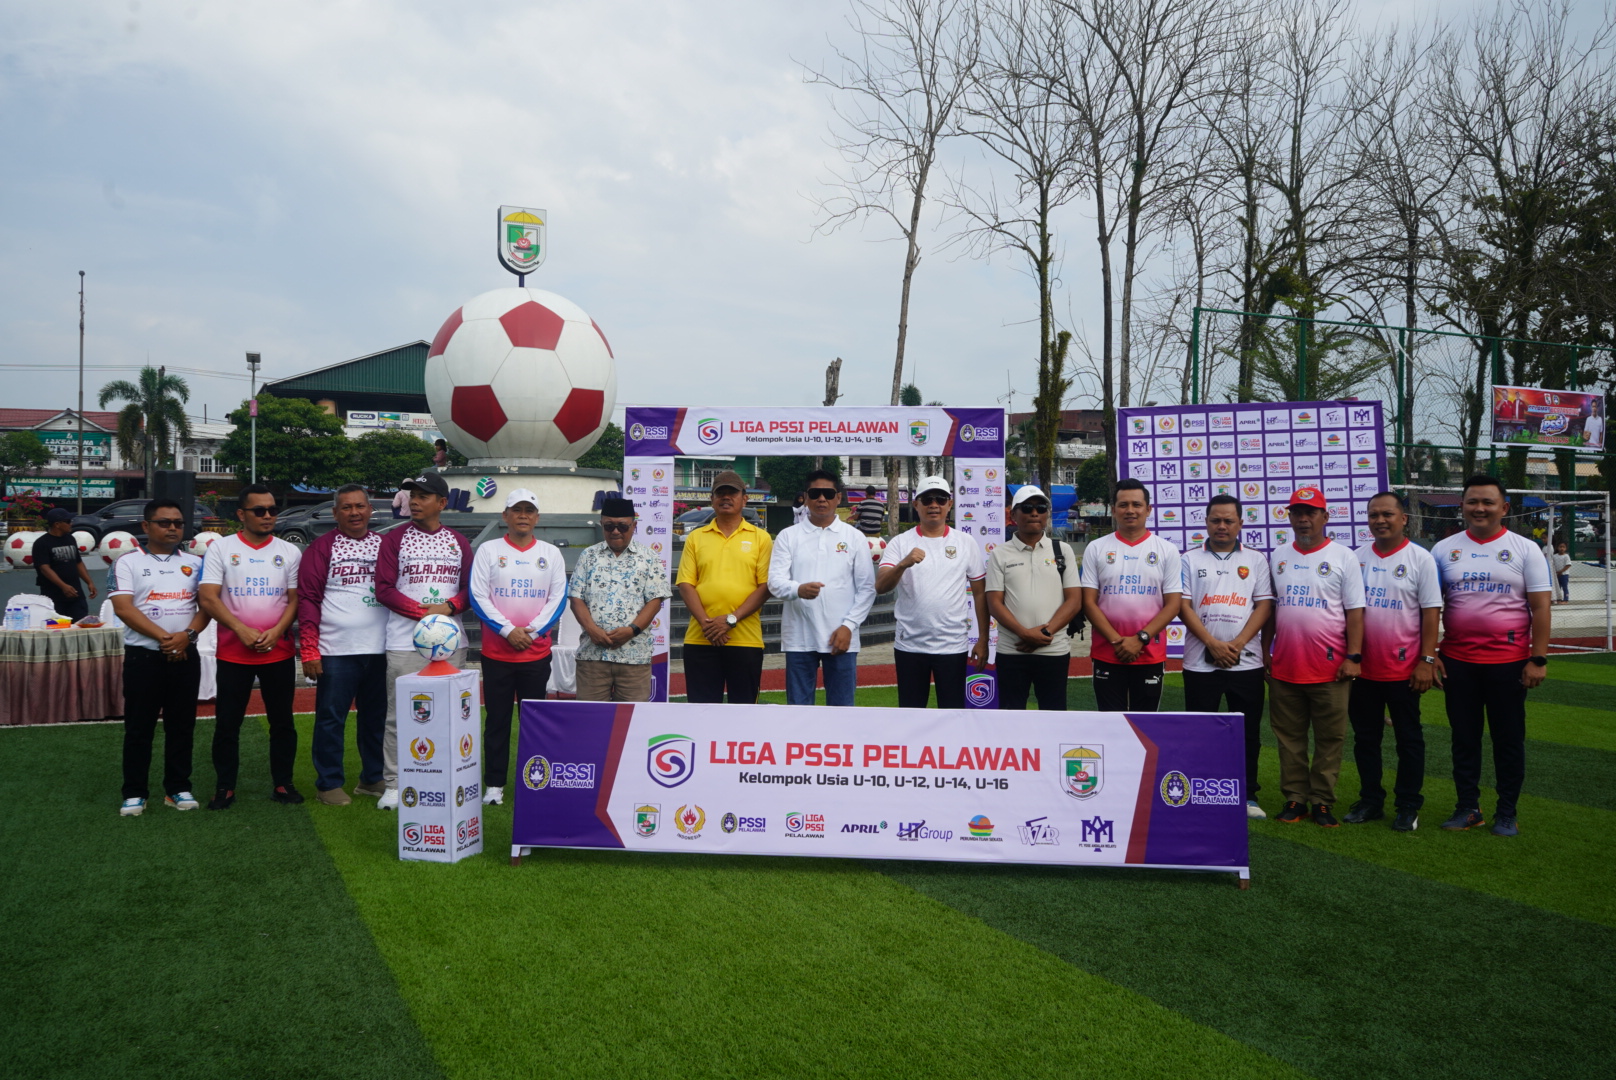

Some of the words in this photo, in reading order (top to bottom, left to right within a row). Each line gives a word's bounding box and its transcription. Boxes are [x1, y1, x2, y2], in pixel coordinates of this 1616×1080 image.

[645, 426, 667, 435] PSSI
[730, 421, 765, 433] LIGA
[769, 421, 804, 433] PSSI
[809, 421, 899, 434] PELALAWAN
[975, 428, 998, 436] PSSI
[1198, 569, 1207, 578] ES
[1463, 572, 1490, 581] PSSI
[246, 577, 269, 586] PSSI
[342, 576, 367, 585] BOAT
[409, 576, 429, 584] BOAT
[432, 576, 458, 584] RACING
[511, 579, 532, 588] PSSI
[1120, 575, 1141, 584] PSSI
[228, 587, 284, 596] PELALAWAN
[495, 588, 546, 598] PELALAWAN
[1103, 585, 1157, 595] PELALAWAN
[1286, 585, 1310, 595] PSSI
[710, 741, 776, 765] LIGA
[786, 742, 853, 767] PSSI
[863, 744, 1040, 771] PELALAWAN
[552, 763, 595, 781] PSSI
[550, 780, 594, 788] PELALAWAN
[739, 772, 812, 786] Kelompok
[816, 774, 849, 786] Usia
[853, 775, 890, 788] U-10,
[894, 776, 930, 789] U-12,
[934, 777, 971, 790] U-14,
[975, 778, 1009, 790] U-16
[465, 783, 478, 798] PSSI
[1191, 778, 1239, 797] PSSI
[419, 791, 445, 802] PSSI
[1192, 796, 1239, 805] PELALAWAN
[468, 816, 479, 828] LIGA
[739, 817, 766, 828] PSSI
[805, 814, 824, 822] LIGA
[424, 825, 445, 834] LIGA
[805, 823, 824, 832] PSSI
[841, 824, 880, 833] APRIL
[468, 827, 479, 839] PSSI
[424, 836, 445, 845] PSSI
